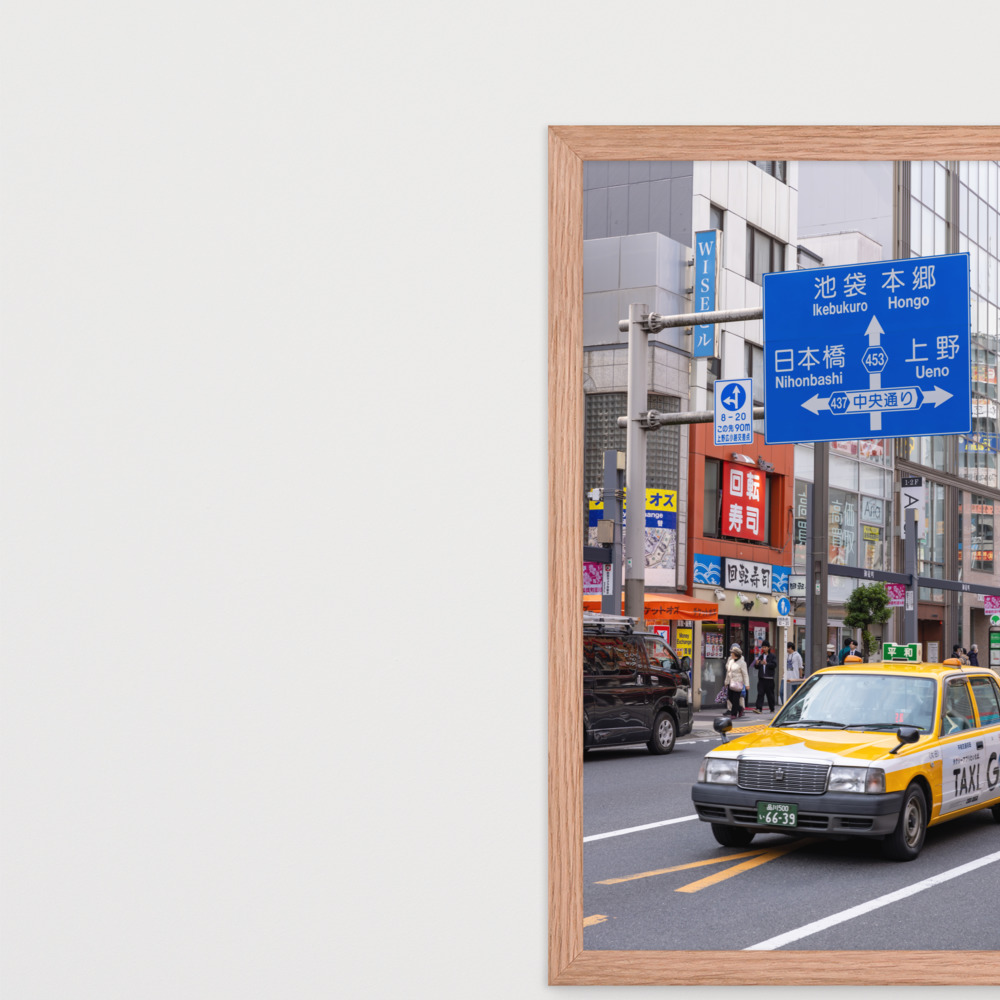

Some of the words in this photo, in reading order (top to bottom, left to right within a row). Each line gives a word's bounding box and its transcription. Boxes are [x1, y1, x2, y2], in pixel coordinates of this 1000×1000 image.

[697, 240, 714, 348] WISEル
[814, 272, 867, 300] 池袋
[881, 264, 937, 293] 本郷
[812, 300, 868, 317] Ikebukuro
[888, 296, 930, 310] Hongo
[774, 344, 846, 373] 日本橋
[865, 352, 886, 367] 453
[905, 334, 960, 363] 上野
[775, 371, 844, 389] Nihonbashi
[915, 365, 950, 380] Ueno
[830, 395, 848, 409] 437
[853, 391, 913, 410] 中央通り
[729, 468, 760, 502] 回転
[728, 503, 760, 536] 寿司
[727, 563, 771, 589] 回転寿司
[887, 646, 914, 658] 平和
[953, 763, 981, 797] TAXI
[765, 811, 796, 825] 66-39
